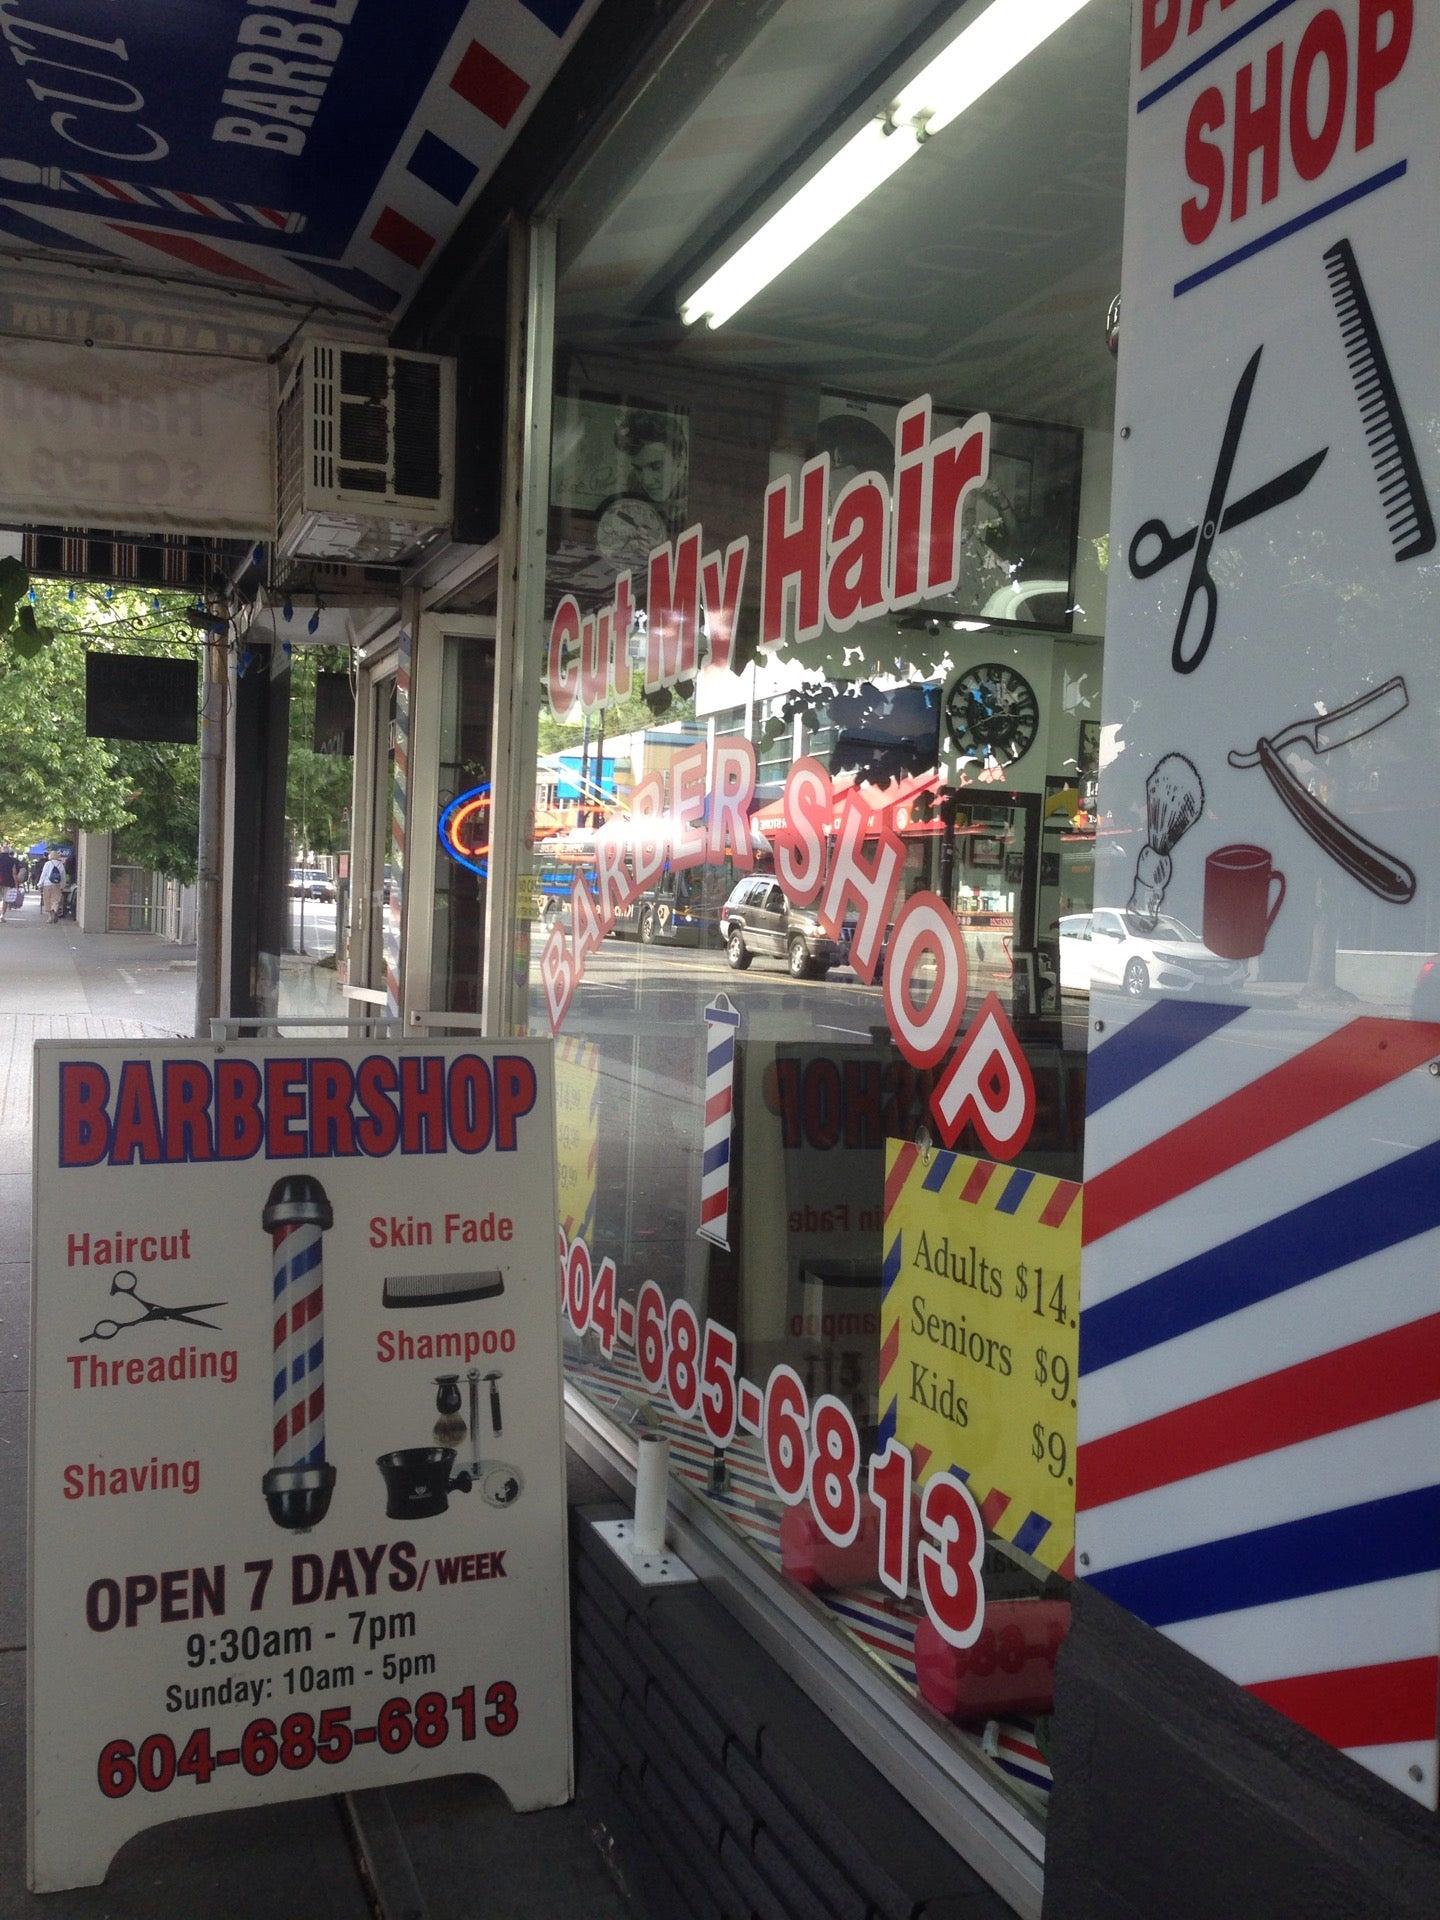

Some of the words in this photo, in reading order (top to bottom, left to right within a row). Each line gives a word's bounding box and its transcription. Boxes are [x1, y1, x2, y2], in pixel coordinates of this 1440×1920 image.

[1180, 0, 1414, 246] SHOP
[548, 570, 635, 717] Cut
[644, 522, 750, 694] My
[760, 393, 992, 650] Hair
[540, 736, 757, 1036] BARBER
[773, 755, 1037, 1162] SHOP
[58, 1054, 538, 1169] BARBERSHOP
[66, 1228, 192, 1267] Haircut
[368, 1215, 433, 1249] Skin
[443, 1211, 515, 1244] Fade
[912, 1229, 1003, 1299] Adults
[66, 1347, 239, 1390] Threading
[376, 1326, 517, 1364] Shampoo
[911, 1295, 1013, 1377] Seniors
[909, 1360, 969, 1428] Kids
[62, 1459, 201, 1501] Shaving
[85, 1564, 226, 1633] OPEN
[243, 1560, 274, 1612] 7
[186, 1624, 313, 1669] 9:30am
[347, 1610, 417, 1651] 7pm
[165, 1676, 273, 1714] Sunday:
[282, 1664, 355, 1696] 10am
[381, 1651, 437, 1685] 5pm
[96, 1680, 519, 1800] 604-685-6813
